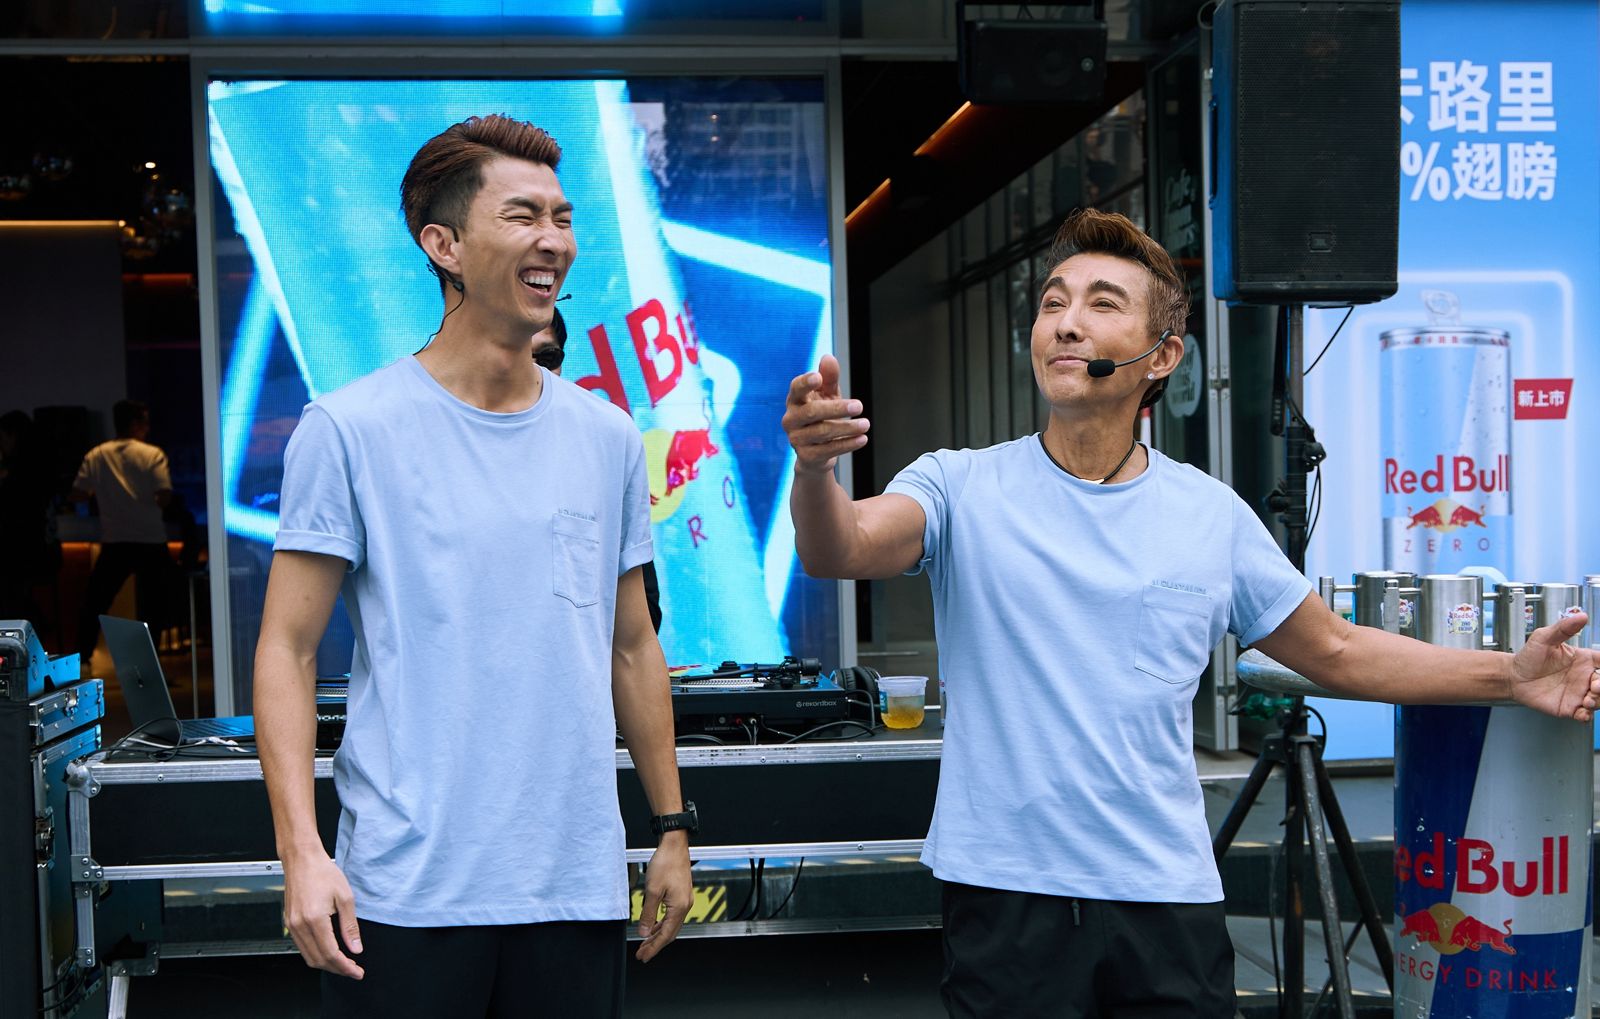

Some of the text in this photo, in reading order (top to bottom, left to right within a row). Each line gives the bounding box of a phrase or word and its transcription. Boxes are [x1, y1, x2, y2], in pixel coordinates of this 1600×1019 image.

[1517, 389, 1566, 409] 新上市
[1385, 455, 1510, 494] Red Bull
[1404, 537, 1491, 553] ZERO
[1394, 832, 1569, 898] ed Bull
[1465, 968, 1558, 991] DRINK
